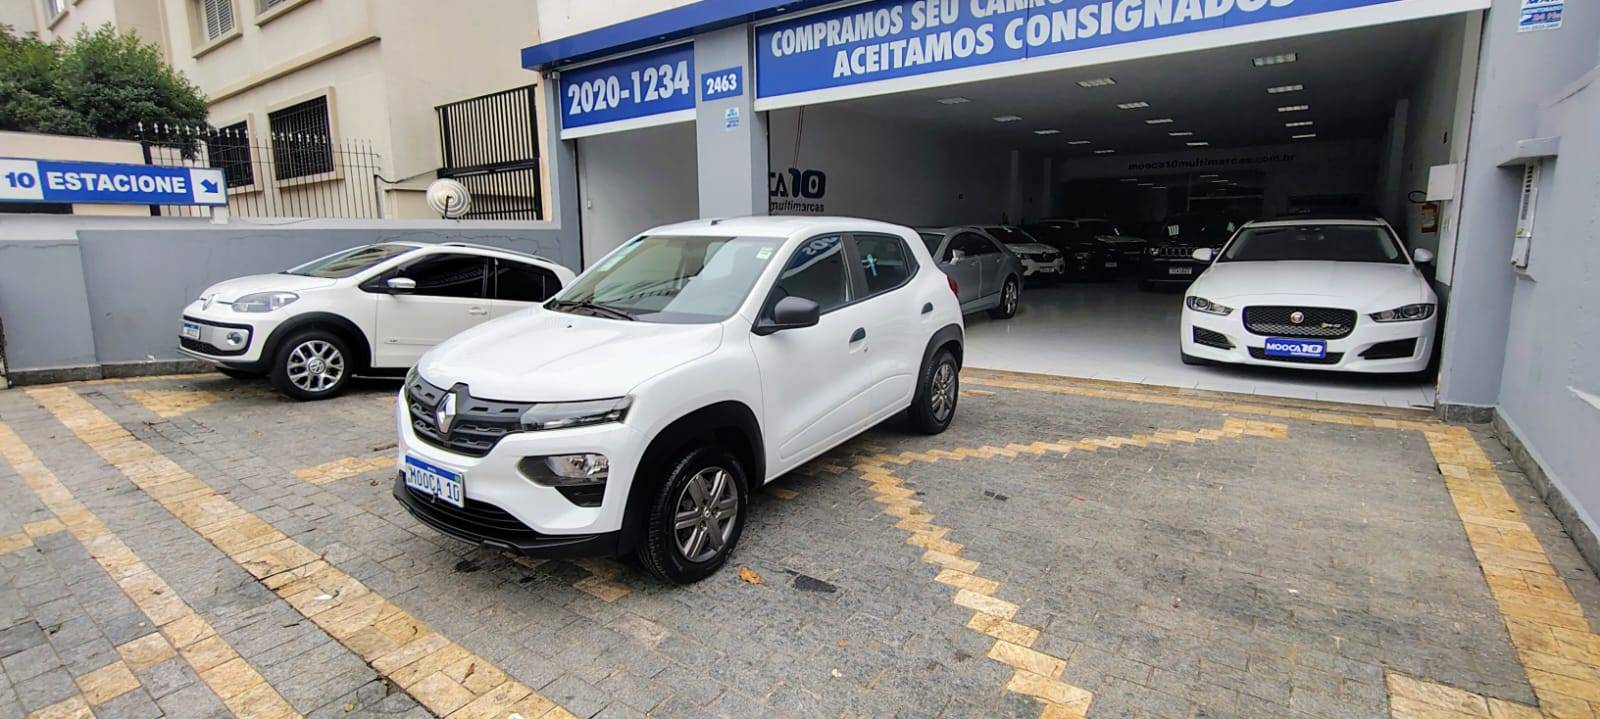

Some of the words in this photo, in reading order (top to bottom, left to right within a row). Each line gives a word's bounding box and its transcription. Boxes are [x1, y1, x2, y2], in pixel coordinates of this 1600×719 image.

[771, 5, 904, 57] COMPRAMOS
[911, 0, 959, 31] SEU
[833, 23, 994, 79] ACEITAMOS
[1004, 0, 1296, 50] CONSIGNAD
[568, 60, 690, 116] 2020-1234
[706, 73, 737, 95] 2463
[5, 172, 36, 189] 10
[46, 172, 188, 193] ESTACIONE
[410, 467, 442, 496] MOOCA
[446, 481, 460, 502] 10
